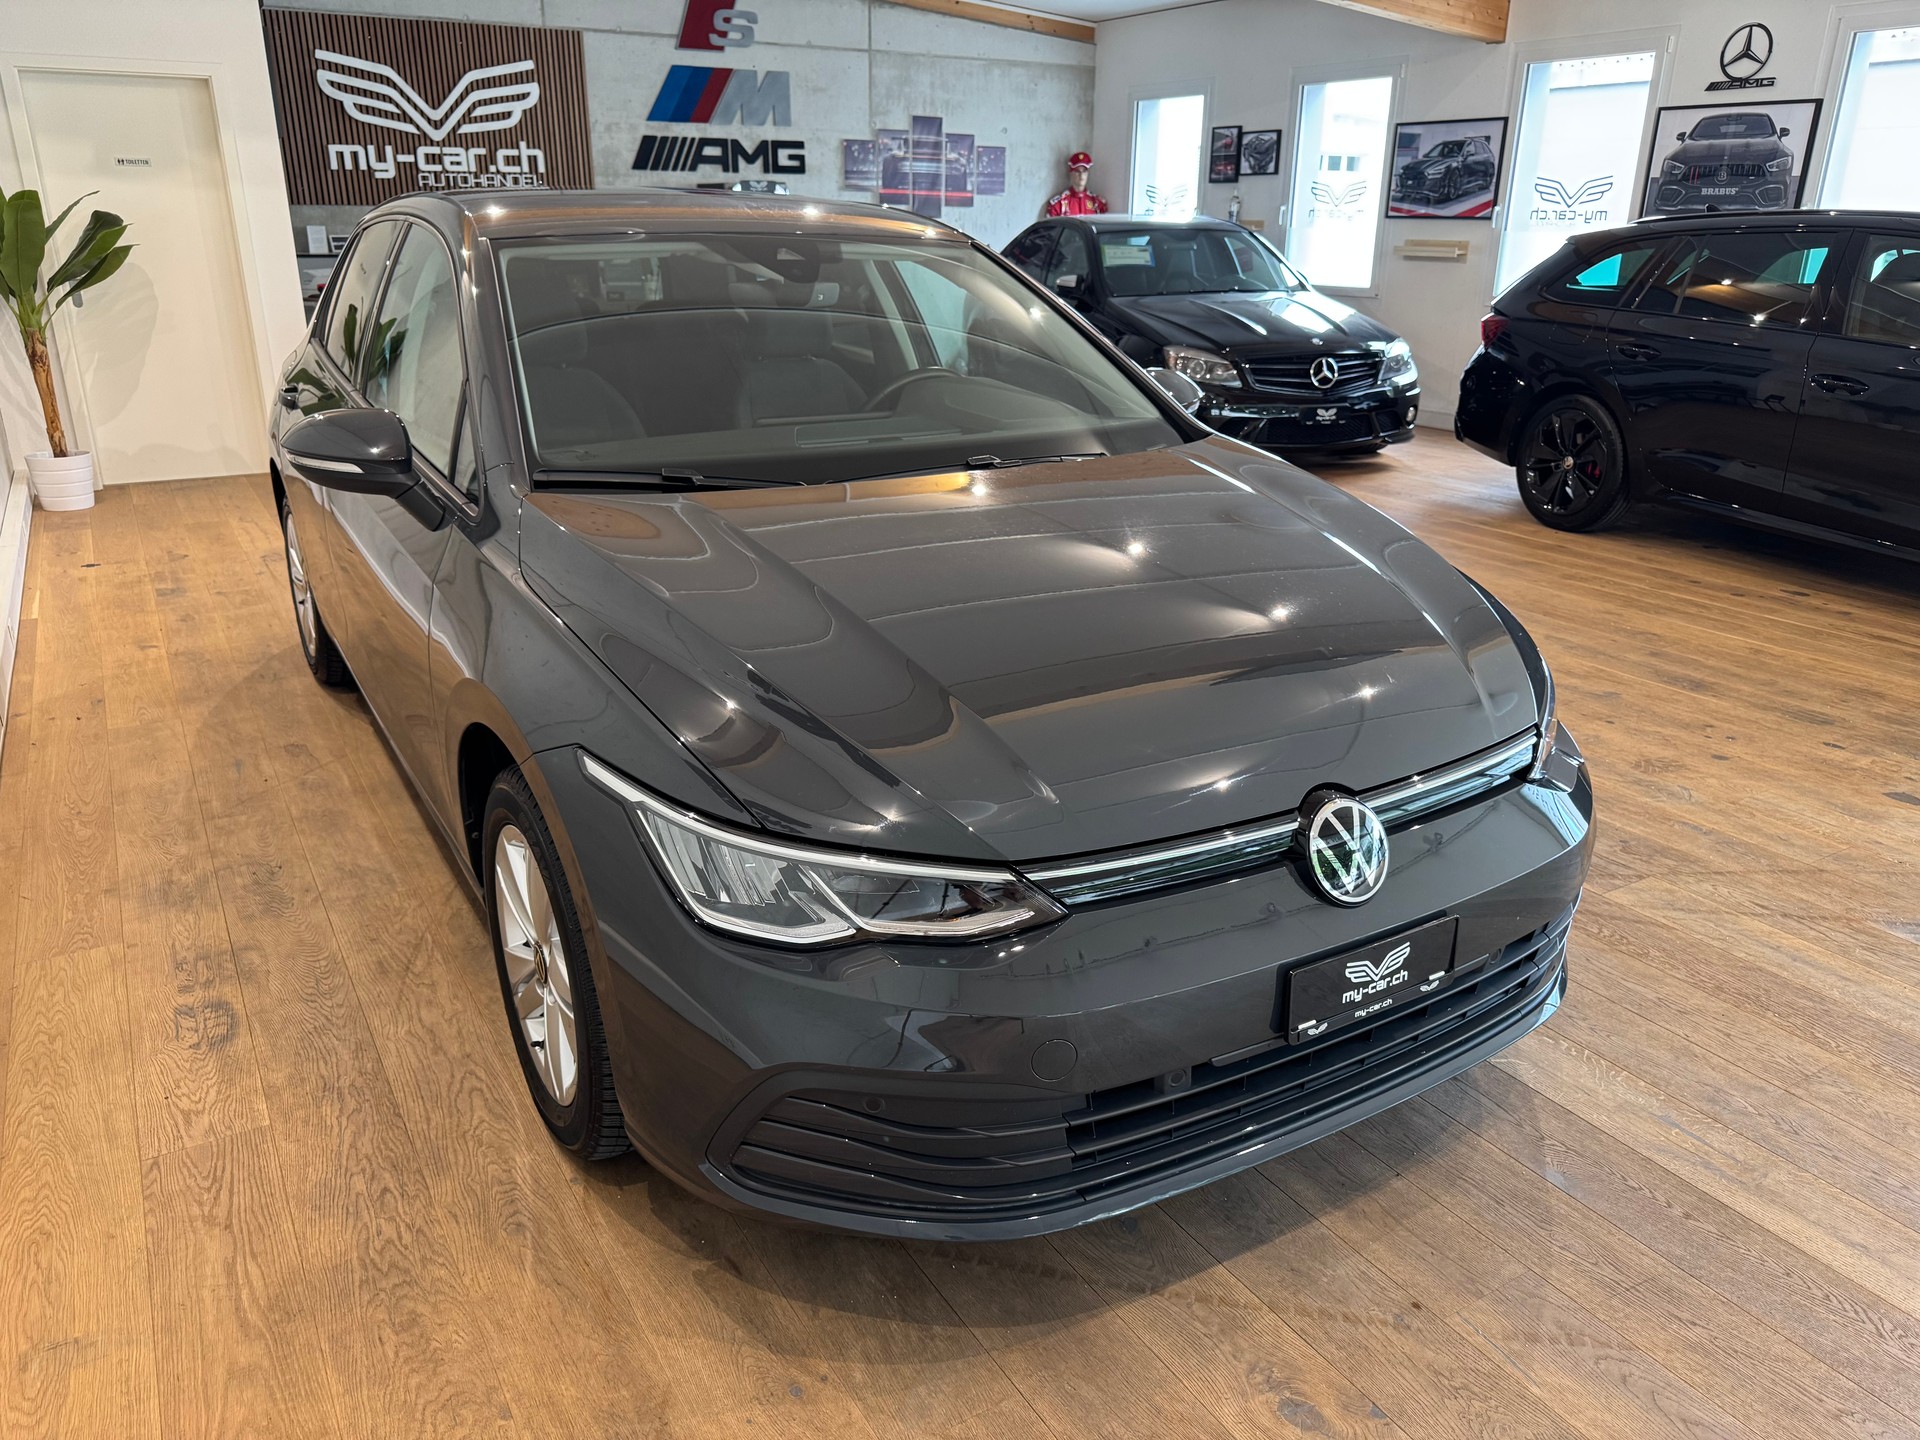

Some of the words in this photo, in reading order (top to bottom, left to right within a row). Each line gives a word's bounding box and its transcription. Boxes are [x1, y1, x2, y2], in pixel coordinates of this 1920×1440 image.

[327, 141, 545, 179] my-car.ch
[1341, 969, 1409, 1004] my-car.ch
[1354, 998, 1393, 1018] my-car.ch
